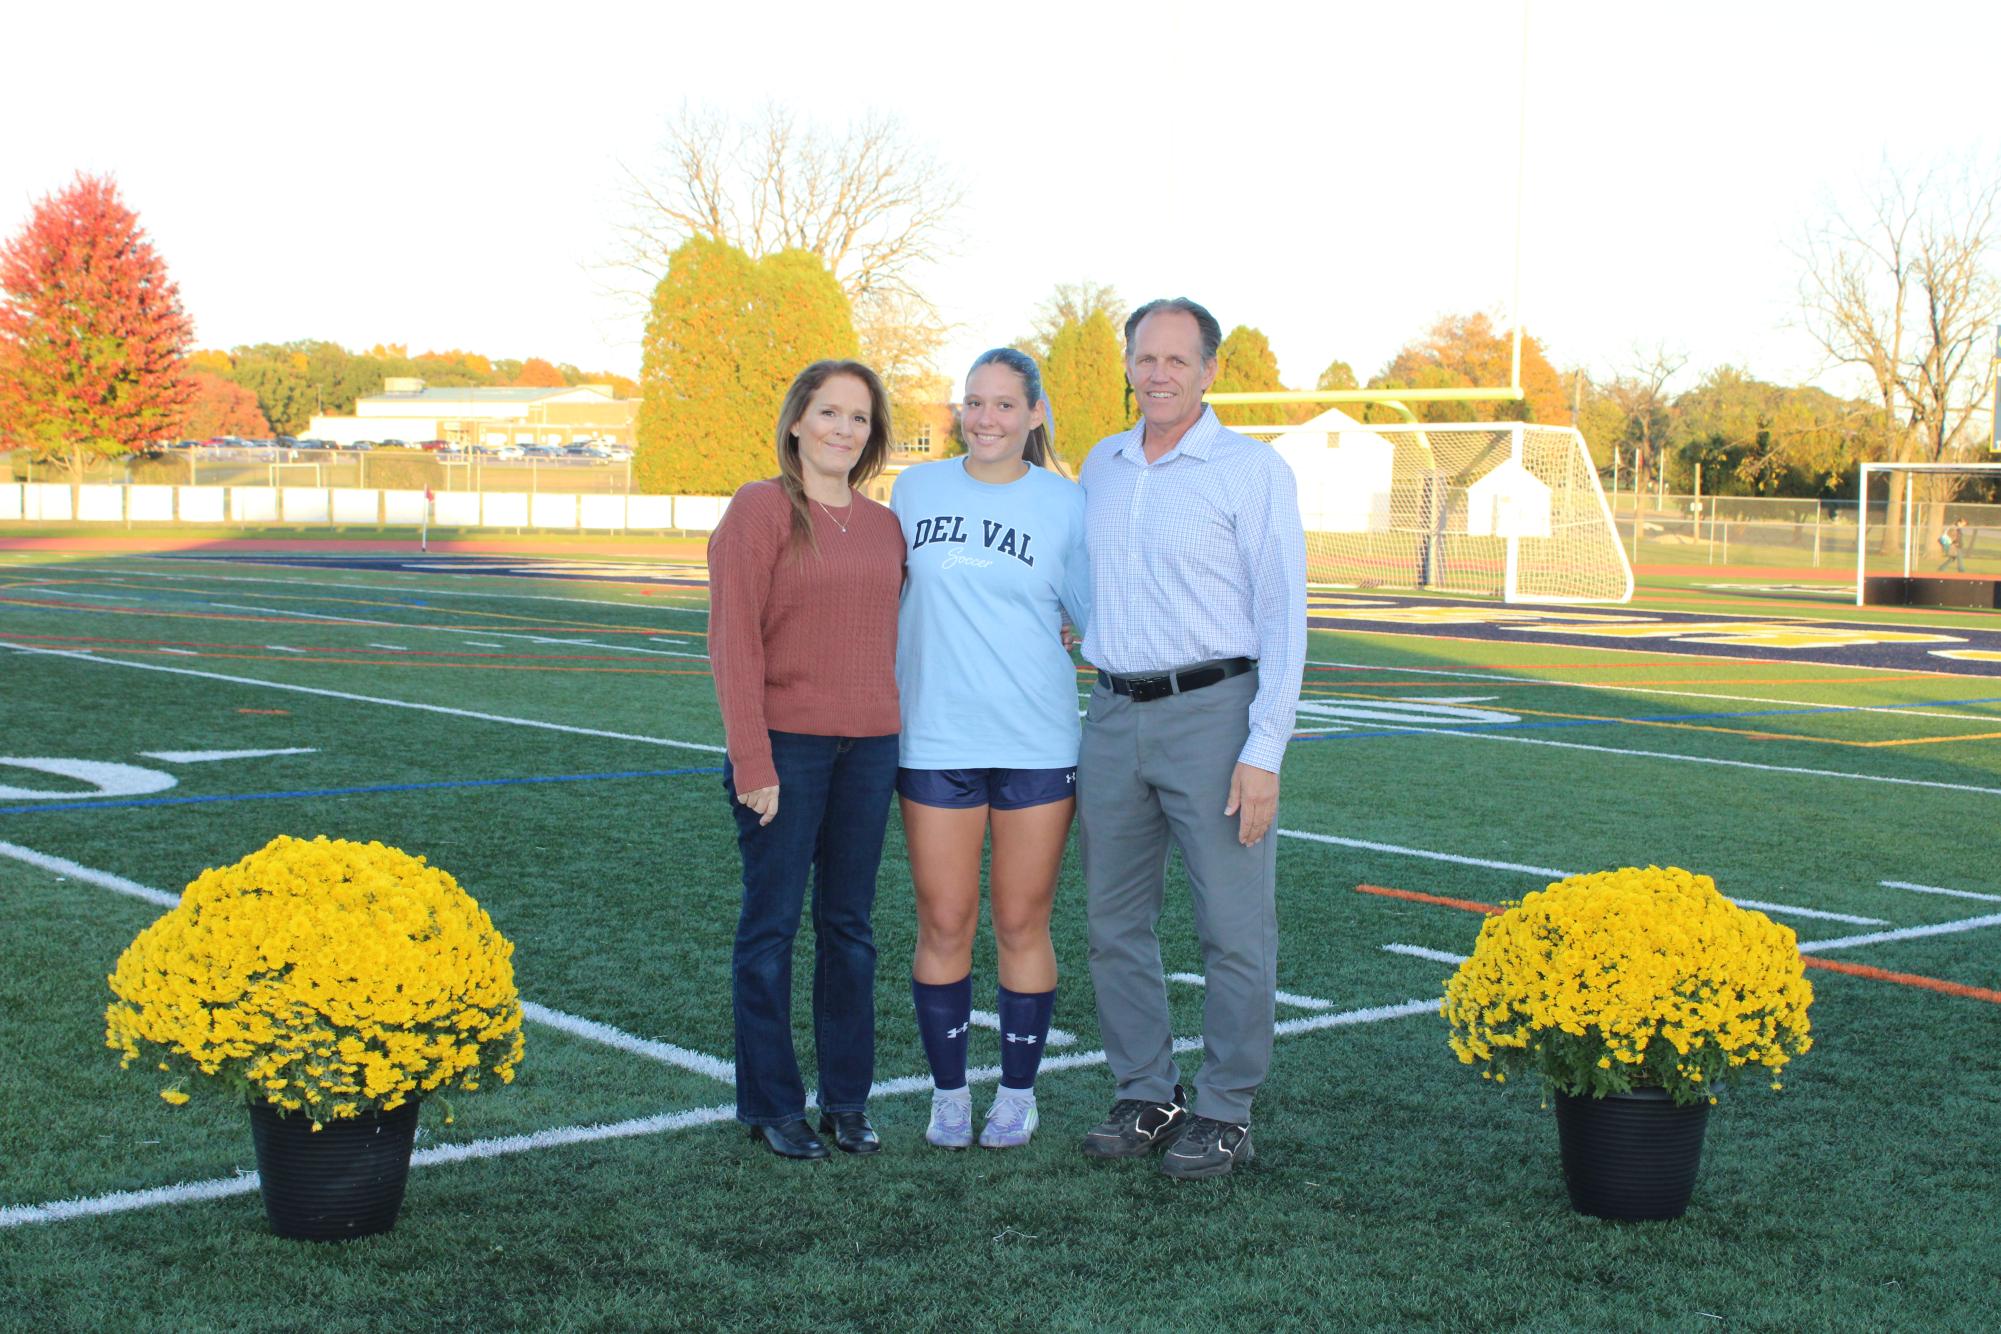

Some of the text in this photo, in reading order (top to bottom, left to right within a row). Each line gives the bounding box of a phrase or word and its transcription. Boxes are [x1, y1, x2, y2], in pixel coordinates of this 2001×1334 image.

[911, 515, 1035, 567] DEL VAL
[942, 547, 993, 569] Soccer
